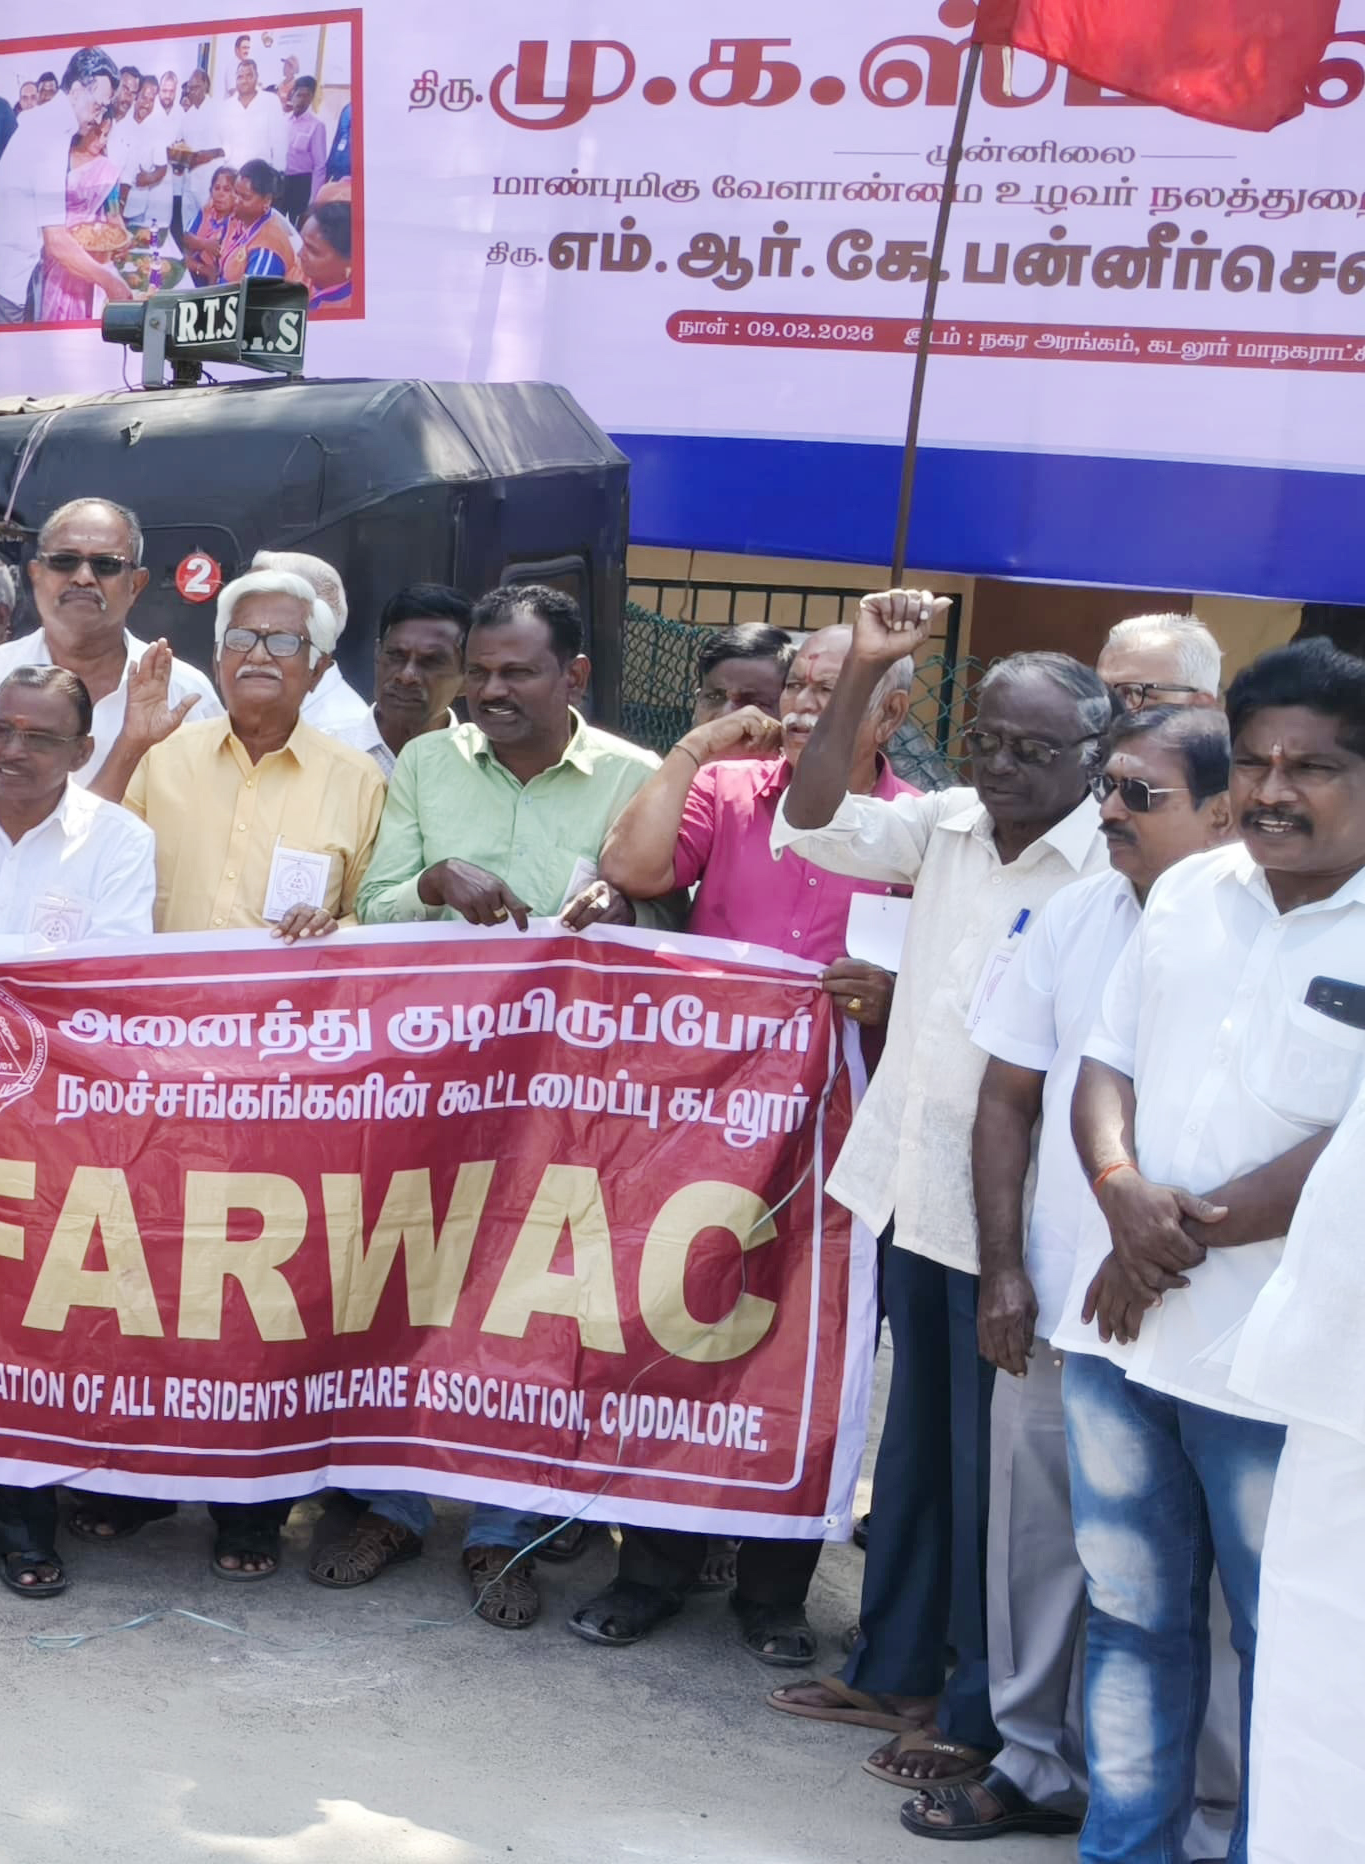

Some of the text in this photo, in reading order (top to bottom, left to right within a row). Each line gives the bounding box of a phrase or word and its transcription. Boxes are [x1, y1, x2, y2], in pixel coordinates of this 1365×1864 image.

[408, 69, 484, 113] திரு.
[492, 167, 701, 204] மாண்புமிகு
[995, 176, 1138, 215] உழவர்
[485, 240, 545, 270] திரு.
[176, 295, 239, 343] R.T.S
[678, 316, 729, 339] நாள்
[747, 318, 875, 343] 09.02.2026
[979, 331, 1029, 352] நகர
[1033, 330, 1141, 356] அரங்கம்,
[1146, 336, 1231, 361] கடலூர்
[186, 558, 212, 594] 2
[57, 999, 373, 1063] அனைத்து
[386, 987, 813, 1053] குடியிருப்போர்
[54, 1069, 810, 1149] நலச்சங்கங்களின் கூட்டமைப்பு கடலூர்
[72, 1373, 106, 1414] OF
[110, 1375, 156, 1417] ALL
[163, 1377, 299, 1422] RESIDENTS
[304, 1366, 409, 1415] WELFARE
[414, 1368, 590, 1440] ASSOCIATION,
[599, 1391, 768, 1453] CUDDALORE.
